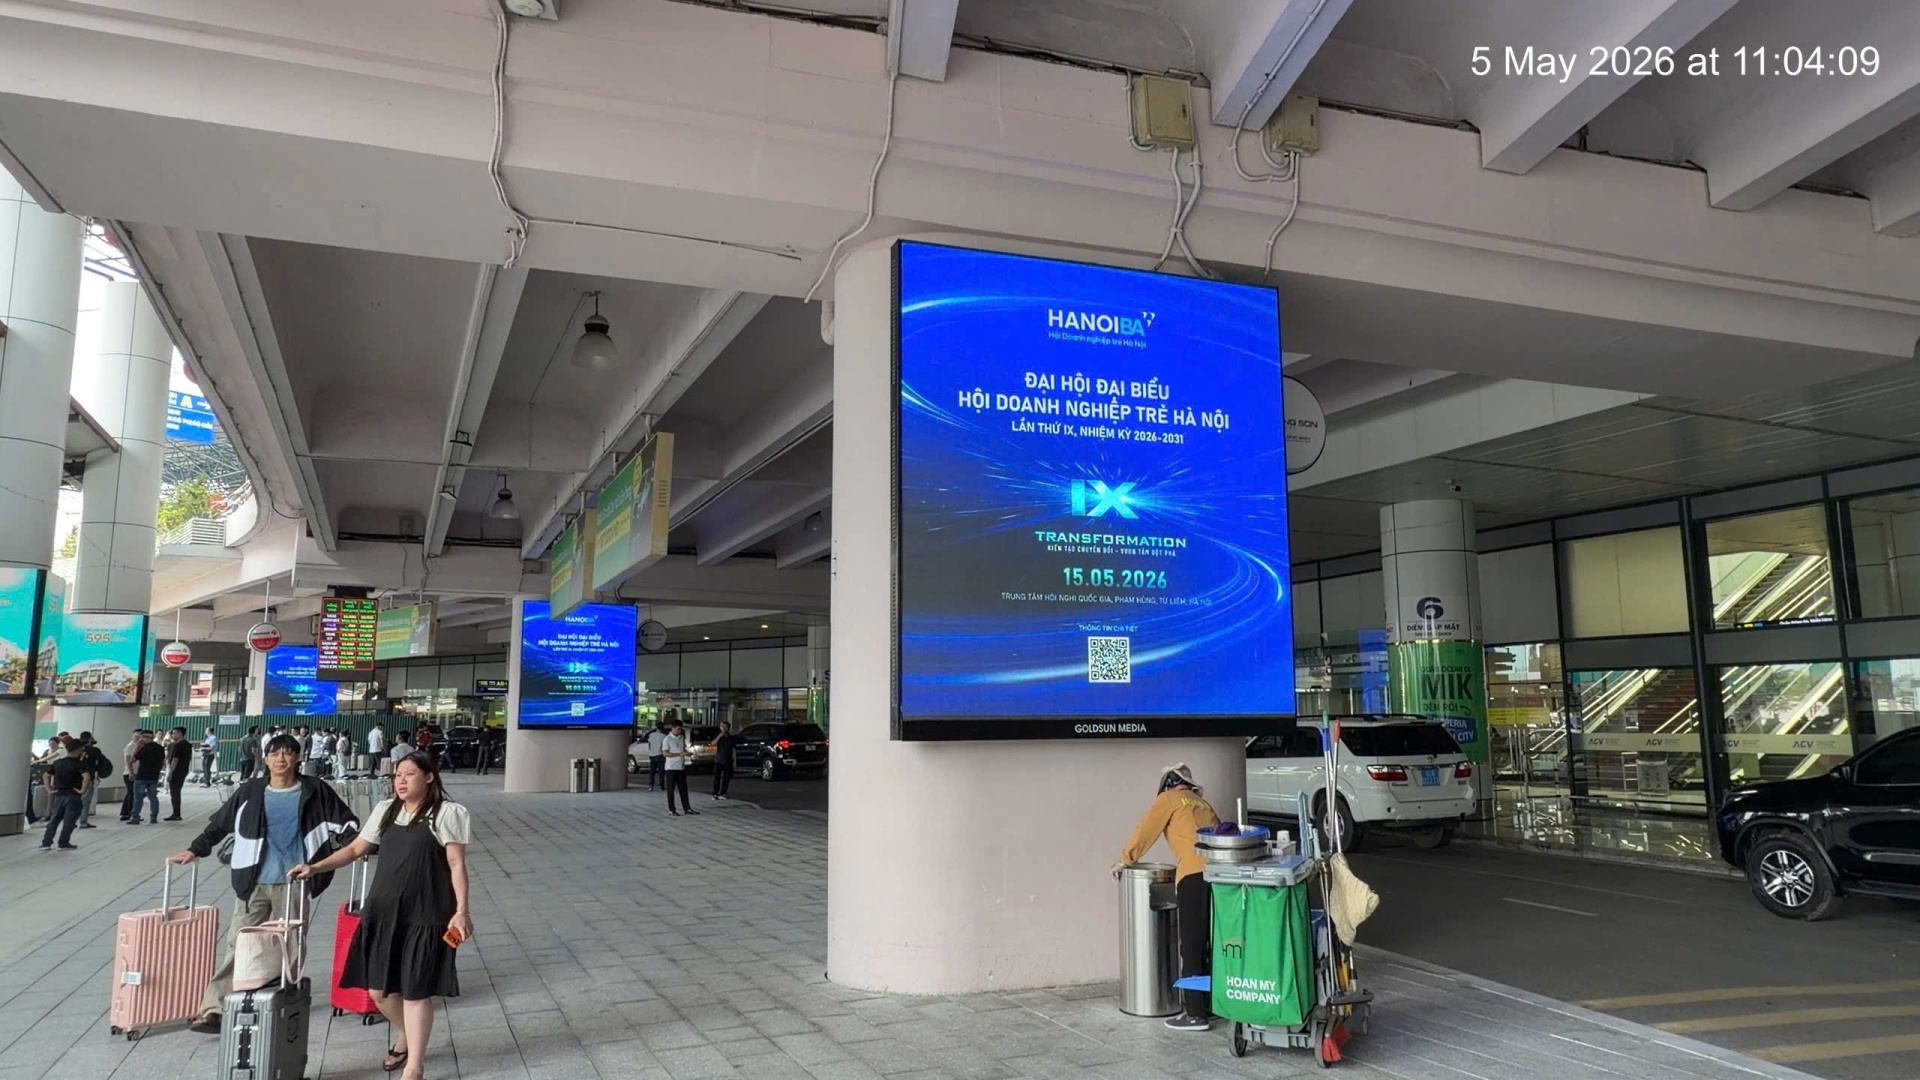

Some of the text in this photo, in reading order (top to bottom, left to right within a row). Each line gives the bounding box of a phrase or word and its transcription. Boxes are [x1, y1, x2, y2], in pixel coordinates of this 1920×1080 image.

[1048, 308, 1146, 337] HANOIBA
[1024, 371, 1170, 400] ĐẠI HỘI ĐẠI BIỂU
[958, 387, 1230, 433] HỘI DOANH NGHIỆP TRẺ HÀ NỘI
[1011, 416, 1185, 445] LẦN THỨ IX, NHIỆM KỲ 2026-2031
[1071, 478, 1139, 519] IX
[1035, 530, 1187, 549] TRANSFORMATION
[1063, 567, 1168, 590] 15.05.2026
[1416, 596, 1444, 620] 6
[85, 632, 110, 643] 595
[1421, 673, 1473, 700] MIK
[1074, 723, 1147, 733] GOLDSUN MEDIA
[1457, 730, 1475, 742] CITY
[1226, 975, 1276, 992] HOAN MY
[1226, 988, 1281, 1005] COMPANY
